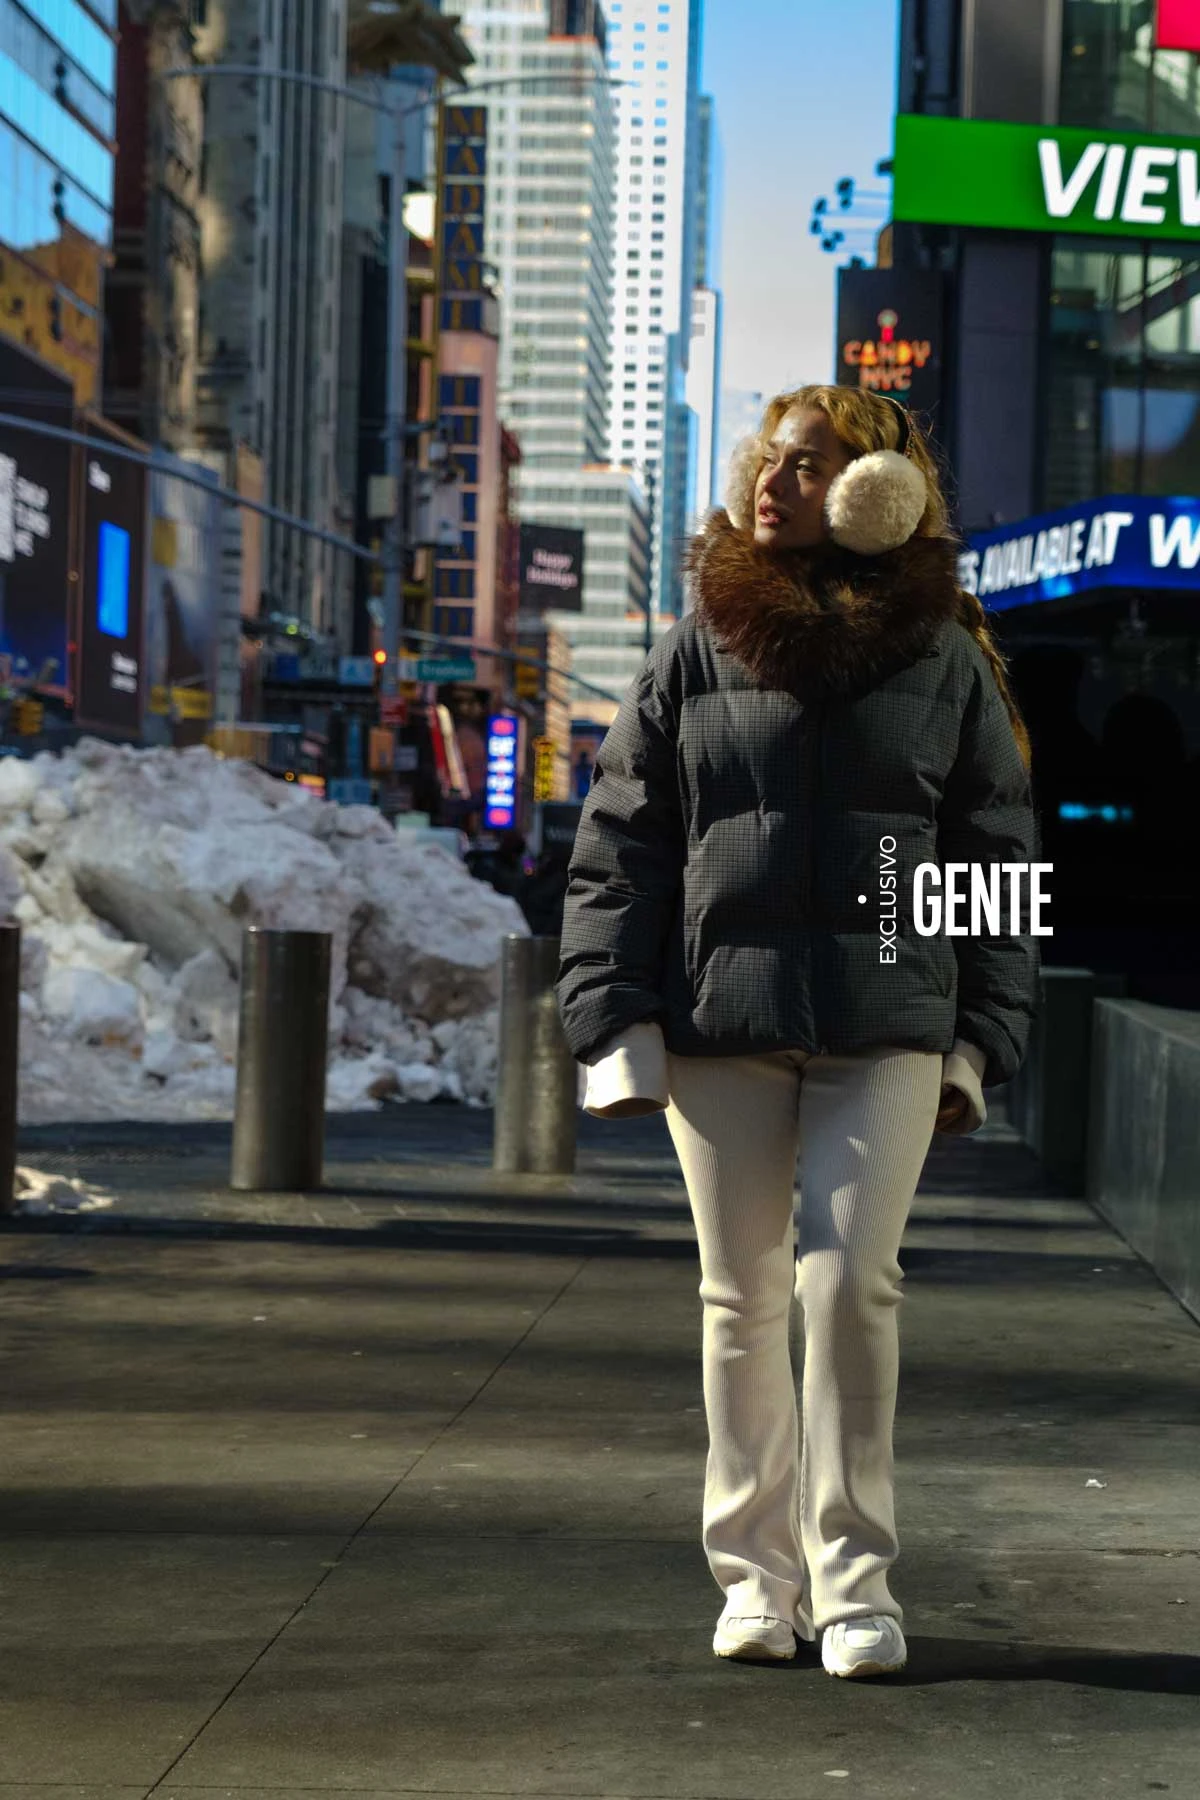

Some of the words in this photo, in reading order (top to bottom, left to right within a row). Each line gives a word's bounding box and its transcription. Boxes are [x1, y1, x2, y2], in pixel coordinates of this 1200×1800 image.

[843, 340, 931, 368] CANDY
[859, 366, 912, 391] NYC
[979, 518, 1086, 596] AVAILABLE
[1084, 511, 1134, 569] AT
